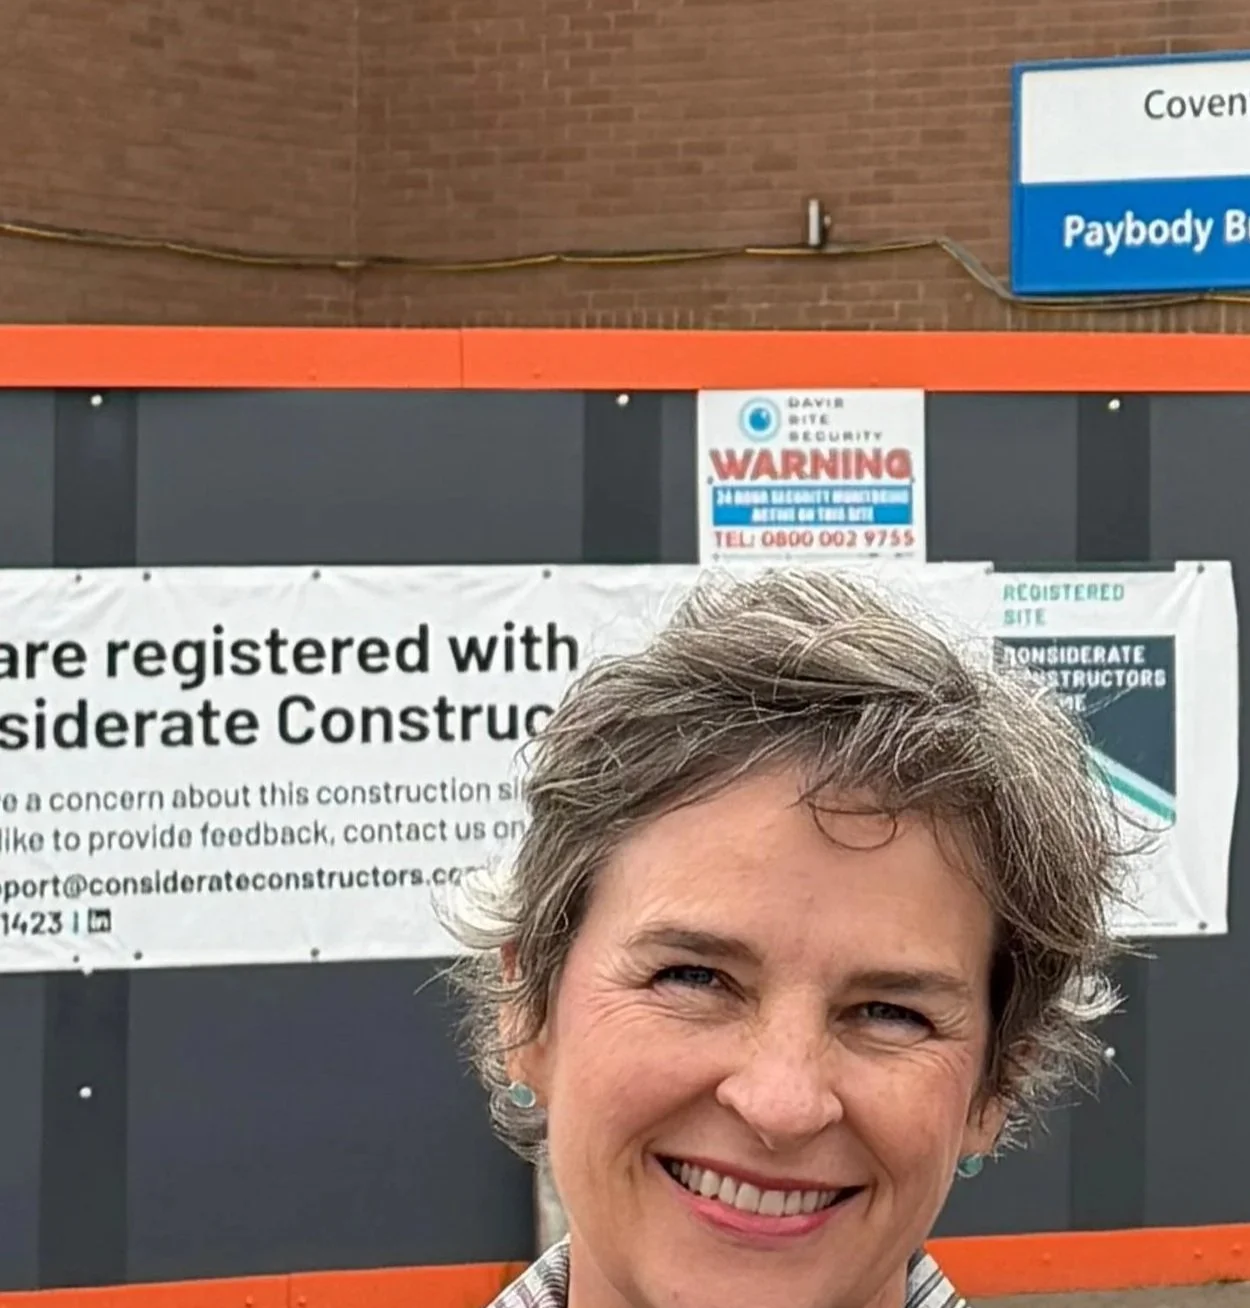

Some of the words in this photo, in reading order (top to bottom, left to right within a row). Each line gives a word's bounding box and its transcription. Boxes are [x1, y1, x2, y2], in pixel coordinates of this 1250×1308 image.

[1063, 209, 1215, 256] Paybody
[789, 430, 883, 442] SECURITY
[709, 449, 912, 481] WARNING
[761, 532, 814, 547] 0800
[819, 532, 858, 547] 002
[864, 531, 915, 547] 9755
[1003, 584, 1125, 601] REGISTERED
[1003, 608, 1046, 627] SITE
[0, 640, 87, 679] are
[106, 623, 429, 690] registered
[448, 620, 578, 673] with
[26, 792, 41, 812] a
[49, 790, 164, 812] concern
[172, 783, 250, 809] about
[259, 780, 309, 807] this
[316, 776, 491, 805] construction
[53, 828, 81, 851] to
[89, 823, 192, 855] provide
[201, 820, 335, 847] feedback,
[344, 819, 447, 845] contact
[455, 822, 486, 841] us
[0, 911, 62, 936] 1423
